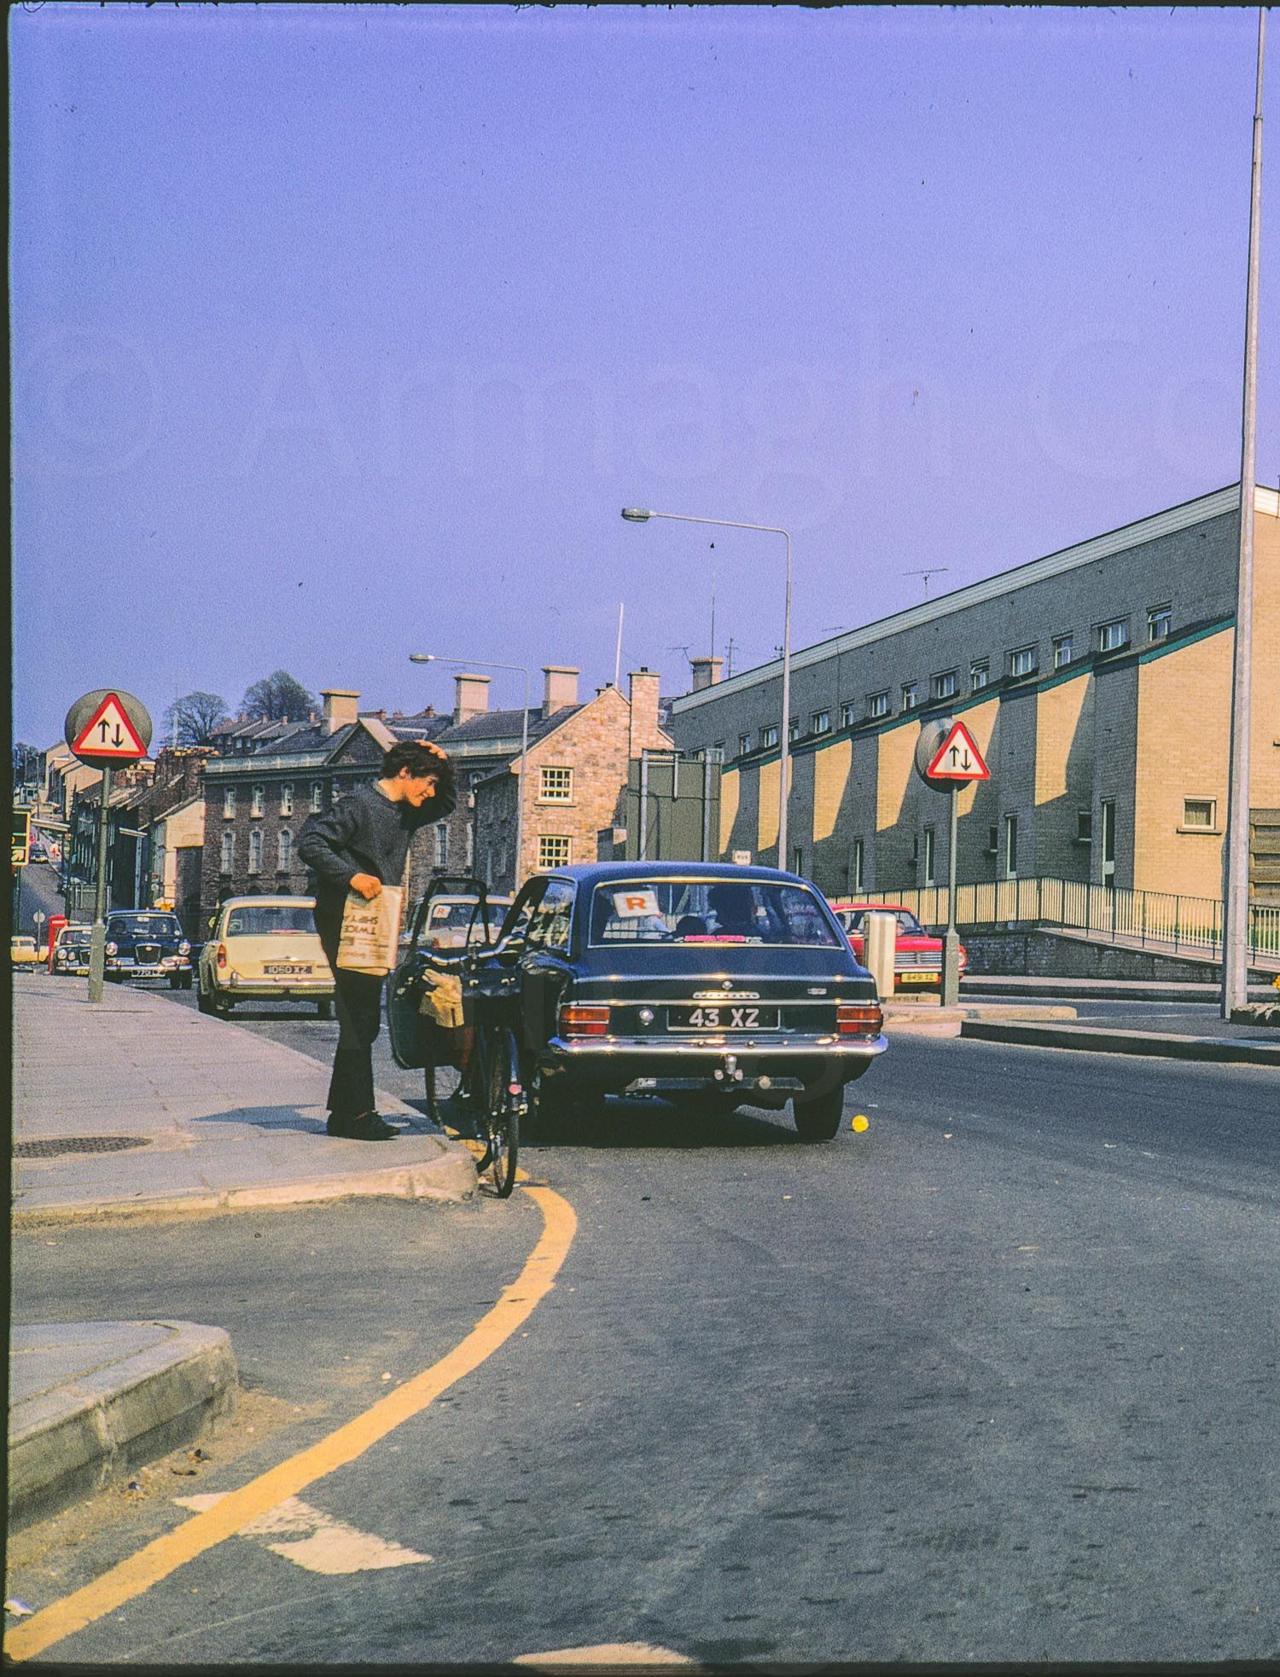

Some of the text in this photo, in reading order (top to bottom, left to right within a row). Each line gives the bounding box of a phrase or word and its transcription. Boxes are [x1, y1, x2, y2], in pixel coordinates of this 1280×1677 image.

[625, 896, 646, 910] R
[689, 1008, 759, 1028] 43 XZ
